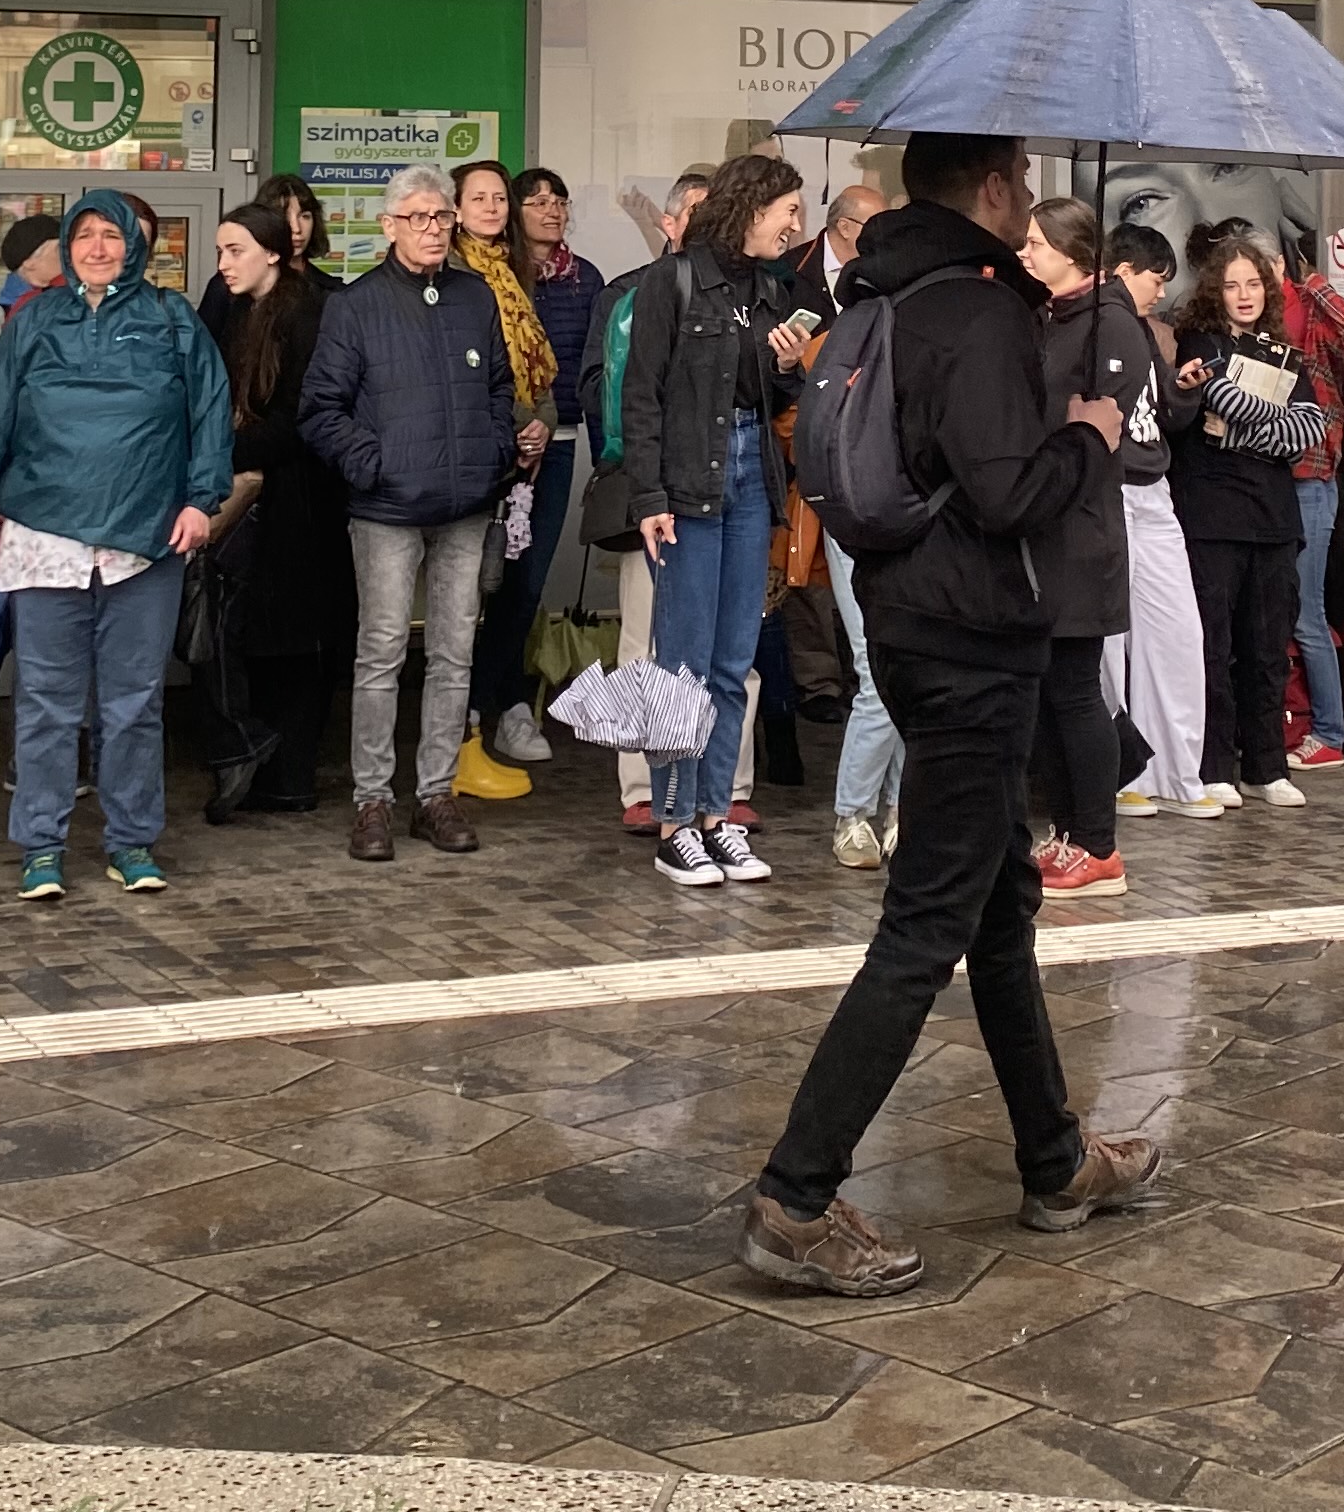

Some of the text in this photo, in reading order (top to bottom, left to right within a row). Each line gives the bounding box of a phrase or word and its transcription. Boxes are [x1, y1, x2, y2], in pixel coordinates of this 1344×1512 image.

[306, 123, 439, 145] szimpatika
[334, 146, 439, 160] gyógyszertár
[311, 165, 378, 179] ÁPRILISI
